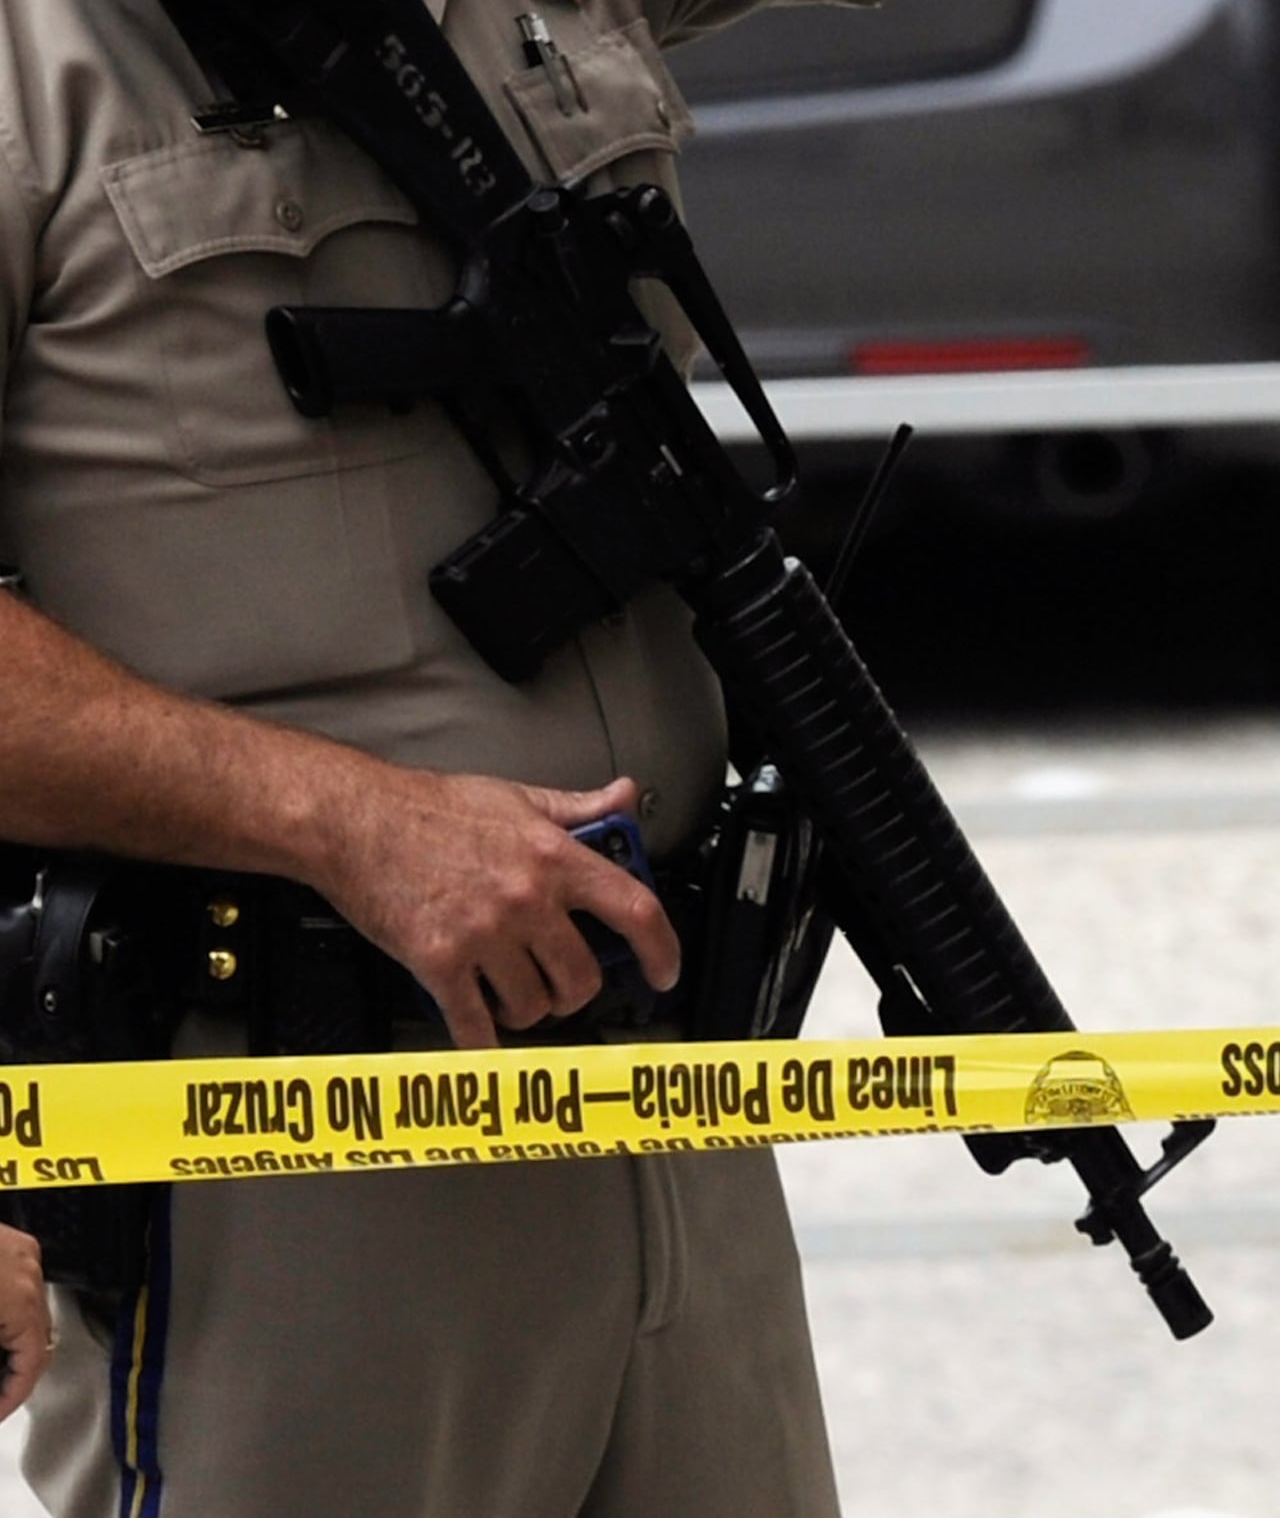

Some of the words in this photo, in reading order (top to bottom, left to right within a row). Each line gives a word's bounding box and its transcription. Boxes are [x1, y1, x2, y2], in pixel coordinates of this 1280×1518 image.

[182, 1079, 314, 1144] Cruzar
[326, 1076, 384, 1142] No
[394, 1071, 503, 1137] Favor
[782, 1059, 835, 1123] De
[847, 1055, 957, 1117] Linea
[33, 1157, 105, 1182] Los
[170, 1150, 333, 1178] Angeles
